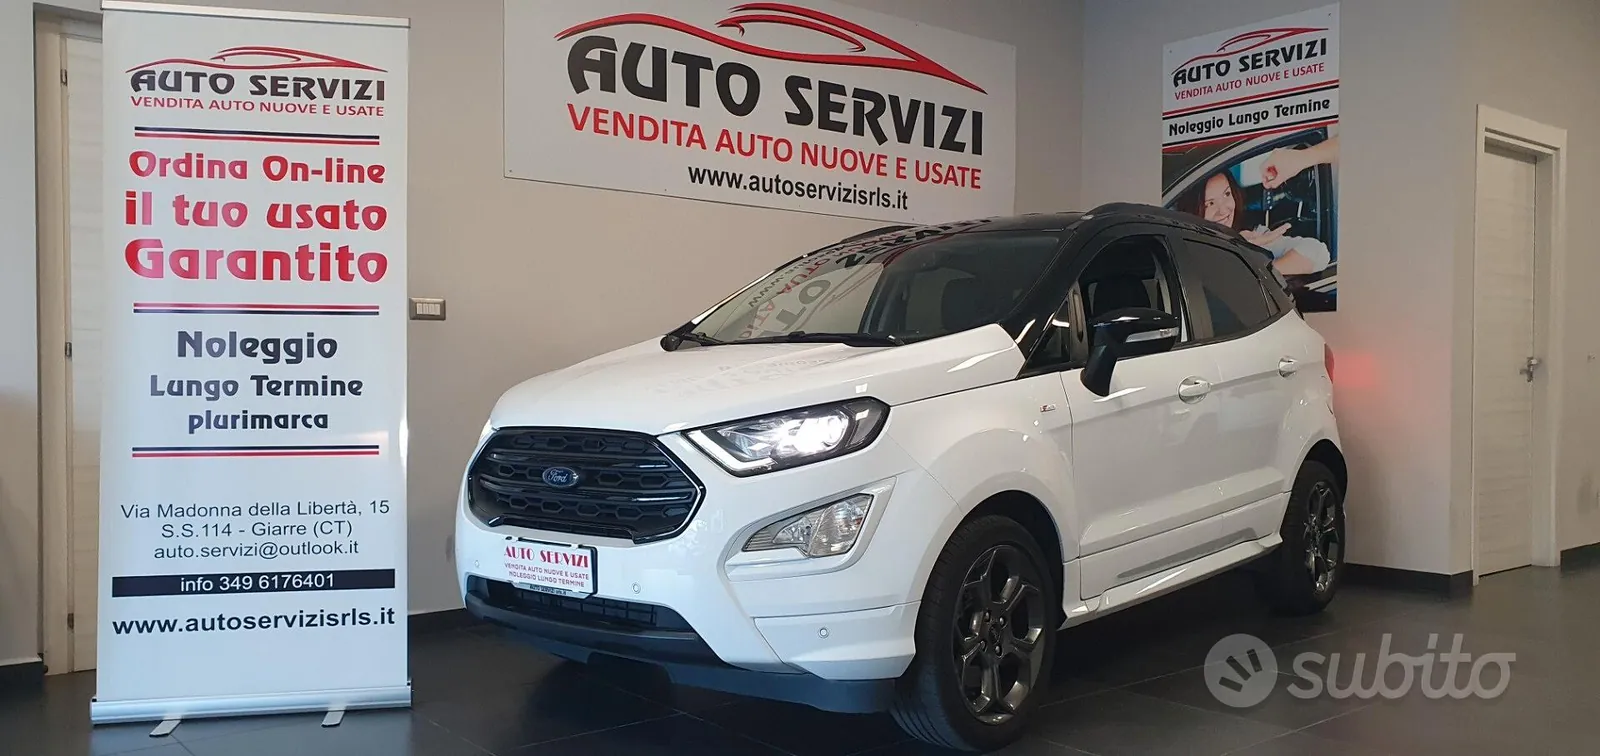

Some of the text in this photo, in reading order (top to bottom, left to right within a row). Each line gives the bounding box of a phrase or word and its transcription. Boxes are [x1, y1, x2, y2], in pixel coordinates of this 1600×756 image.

[1173, 37, 1328, 88] AUTO SERVIZI
[130, 69, 385, 101] AUTO SERVIZI
[567, 34, 984, 156] AUTO SERVIZI
[1174, 62, 1325, 101] VENDITA AUTO NUOVE E USATE
[130, 96, 385, 117] VENDITA AUTO NUOVE E USATE
[1169, 98, 1331, 138] Noleggio Lungo Termine
[567, 103, 982, 190] VENDITA AUTO NUOVE E USATE
[128, 150, 386, 184] Ordina On-line
[688, 165, 908, 211] www.autoservizisrls.it
[125, 190, 387, 231] il tuo usato
[124, 238, 388, 283] Garantito
[177, 331, 338, 365] Noleggio
[150, 374, 363, 402] Lungo Termine
[188, 409, 329, 435] plurimarca
[121, 500, 390, 519] Via Madonna della Libertà, 15
[161, 523, 232, 538] S.S.114
[251, 521, 307, 537] Giarre
[312, 520, 353, 539] (CT)
[154, 541, 359, 560] auto.servizi@outlook.it
[504, 546, 589, 568] AUTO SERVIZI
[180, 573, 334, 592] info 349 6176401
[504, 562, 527, 571] VENDITA
[528, 565, 543, 573] AUTO
[544, 568, 563, 577] NUOVE
[570, 572, 589, 580] USATE
[508, 571, 585, 587] NOLEGGIO LUNGO TERMINE
[112, 607, 396, 635] www.autoservizisrls.it
